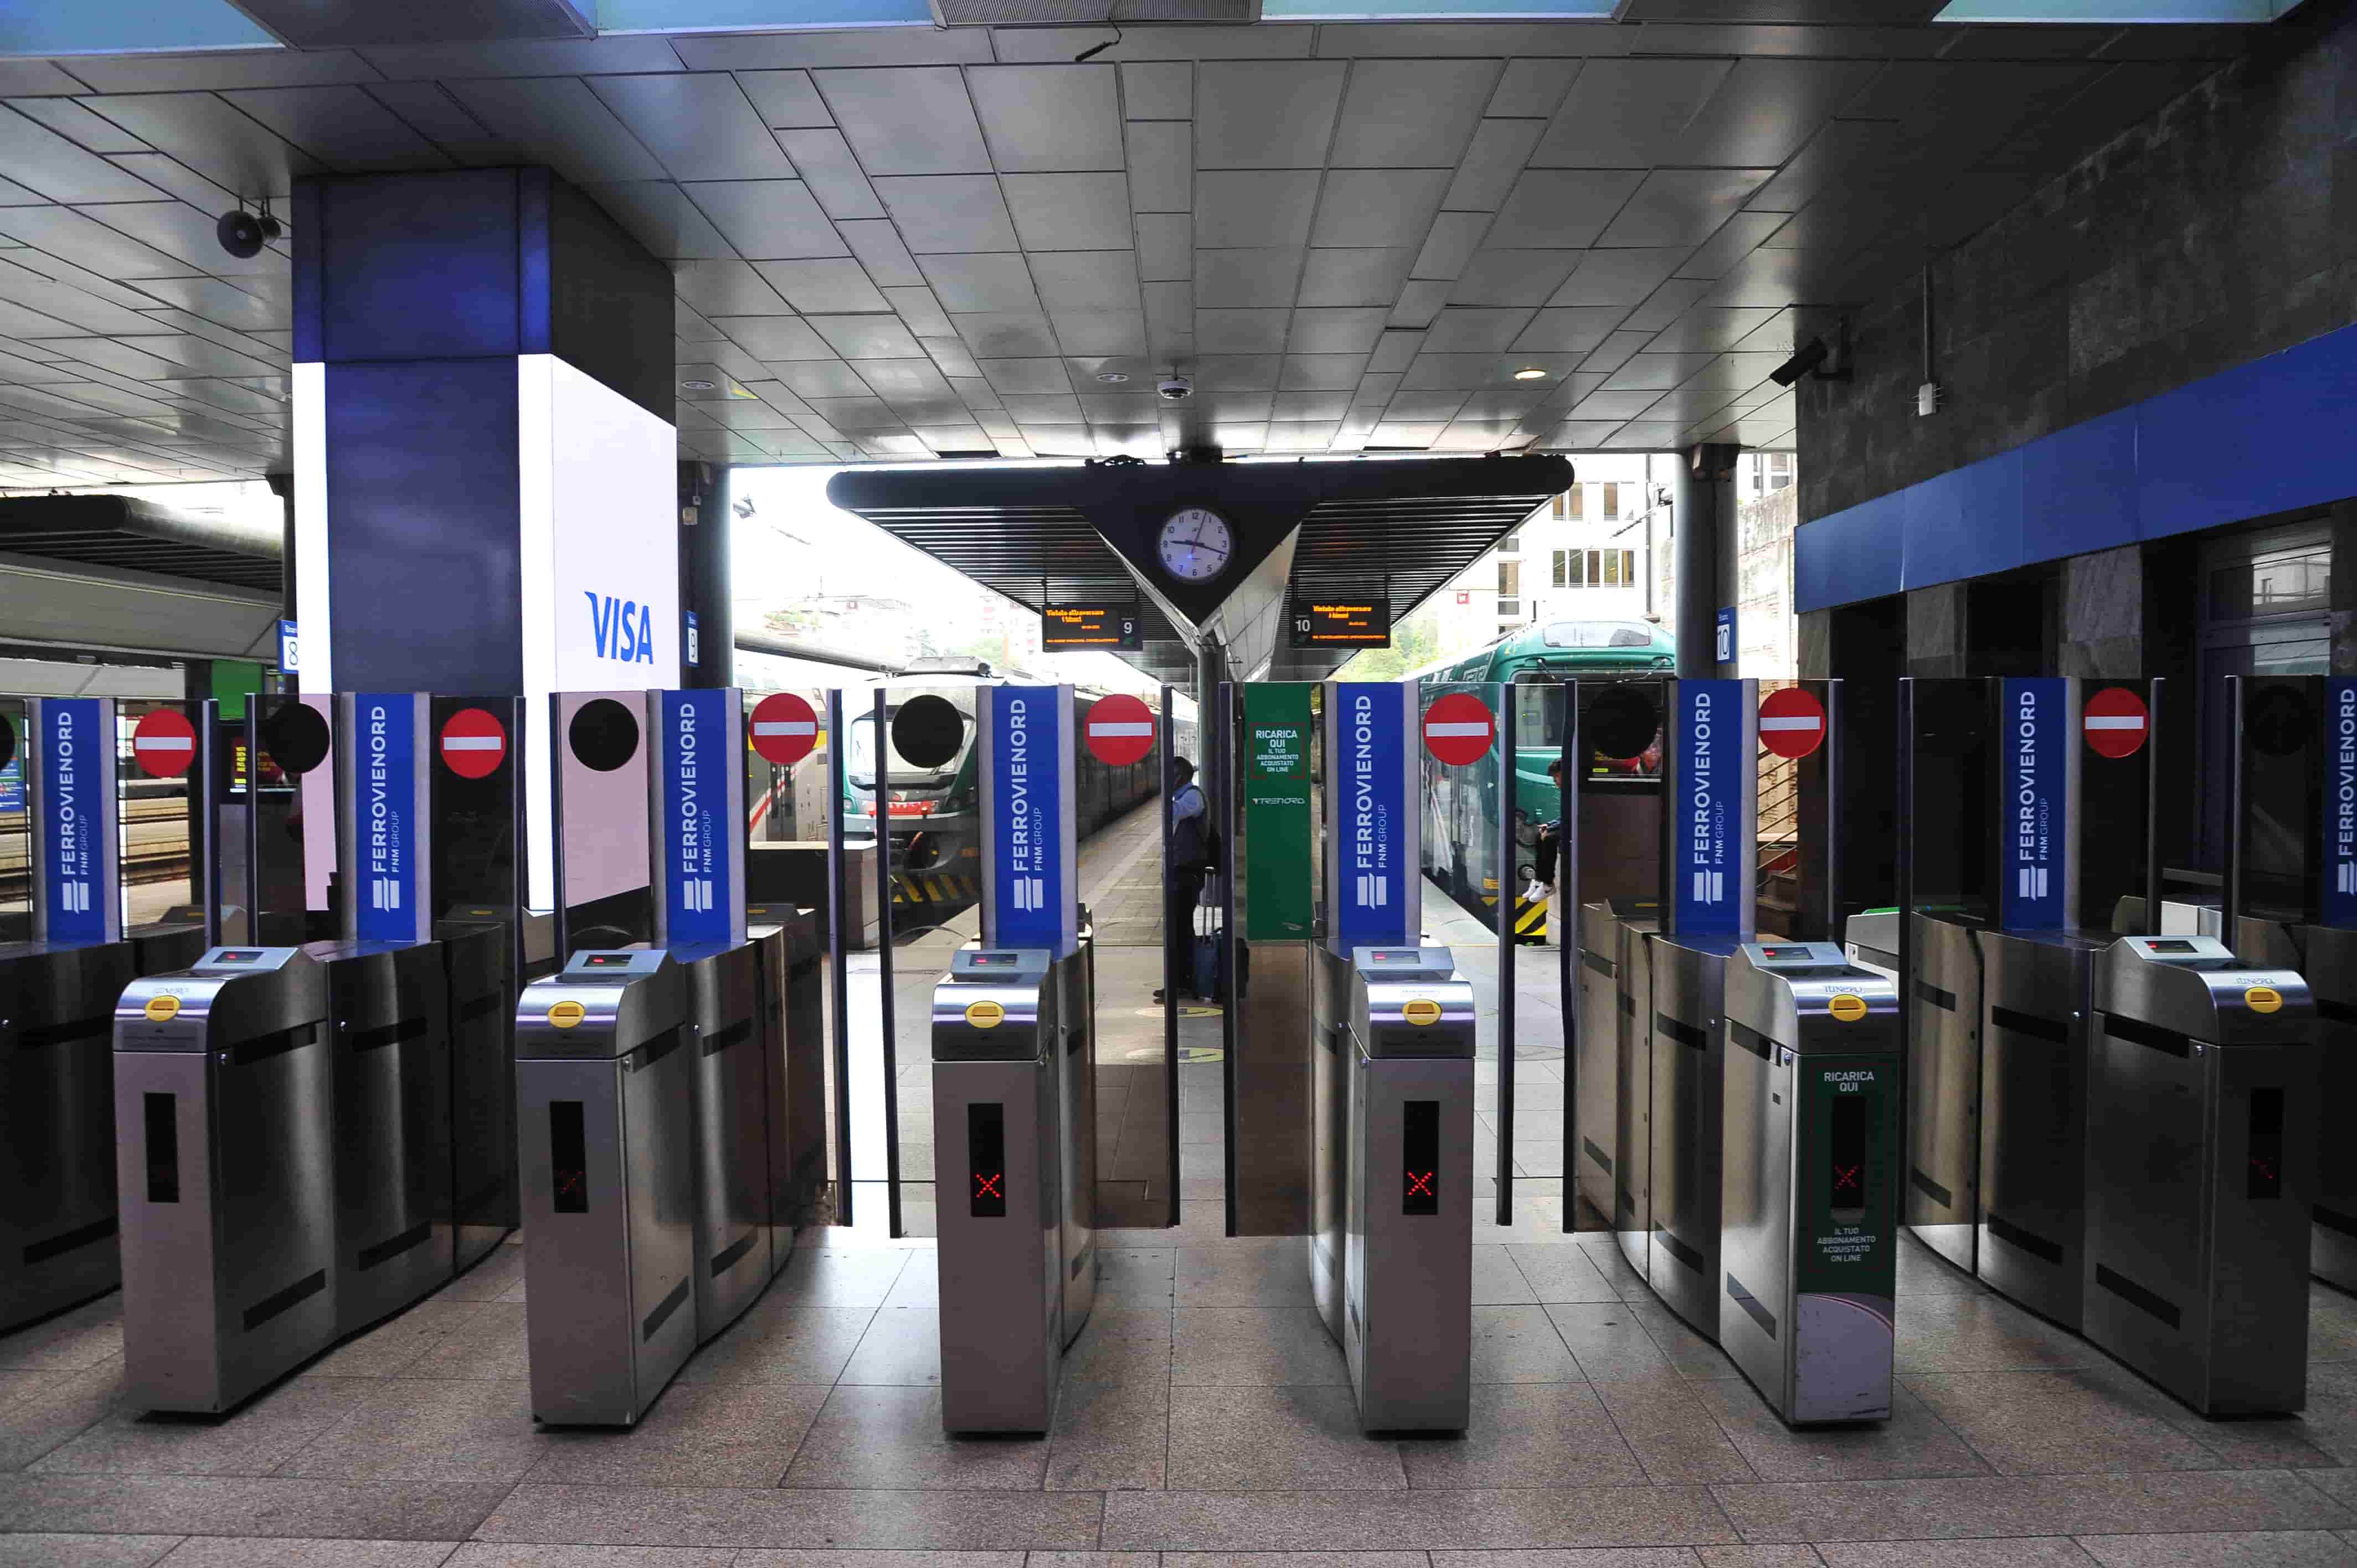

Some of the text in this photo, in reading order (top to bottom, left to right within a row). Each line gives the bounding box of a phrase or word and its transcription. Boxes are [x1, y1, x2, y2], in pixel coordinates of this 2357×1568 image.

[584, 590, 653, 664] VISA
[1124, 622, 1133, 634] 9
[1295, 620, 1310, 632] 10
[1718, 629, 1729, 656] 10
[289, 641, 299, 666] 8
[1255, 730, 1298, 739] RICARICA
[1270, 739, 1285, 747] QUI
[58, 713, 75, 875] FERROVIENORD
[372, 706, 387, 873] FERROVIENORD
[680, 704, 698, 872] FERROVIENORD
[1011, 700, 1028, 870] FERROVIENORD
[1356, 696, 1372, 868] FERROVIENORD
[1694, 693, 1710, 864] FERROVIENORD
[2020, 692, 2035, 860] FERROVIENORD
[2339, 689, 2355, 855] FERROVIENORD
[1824, 1071, 1875, 1081] RICARICA
[1839, 1082, 1858, 1092] QUI
[1823, 1245, 1870, 1254] ACQUISTATO
